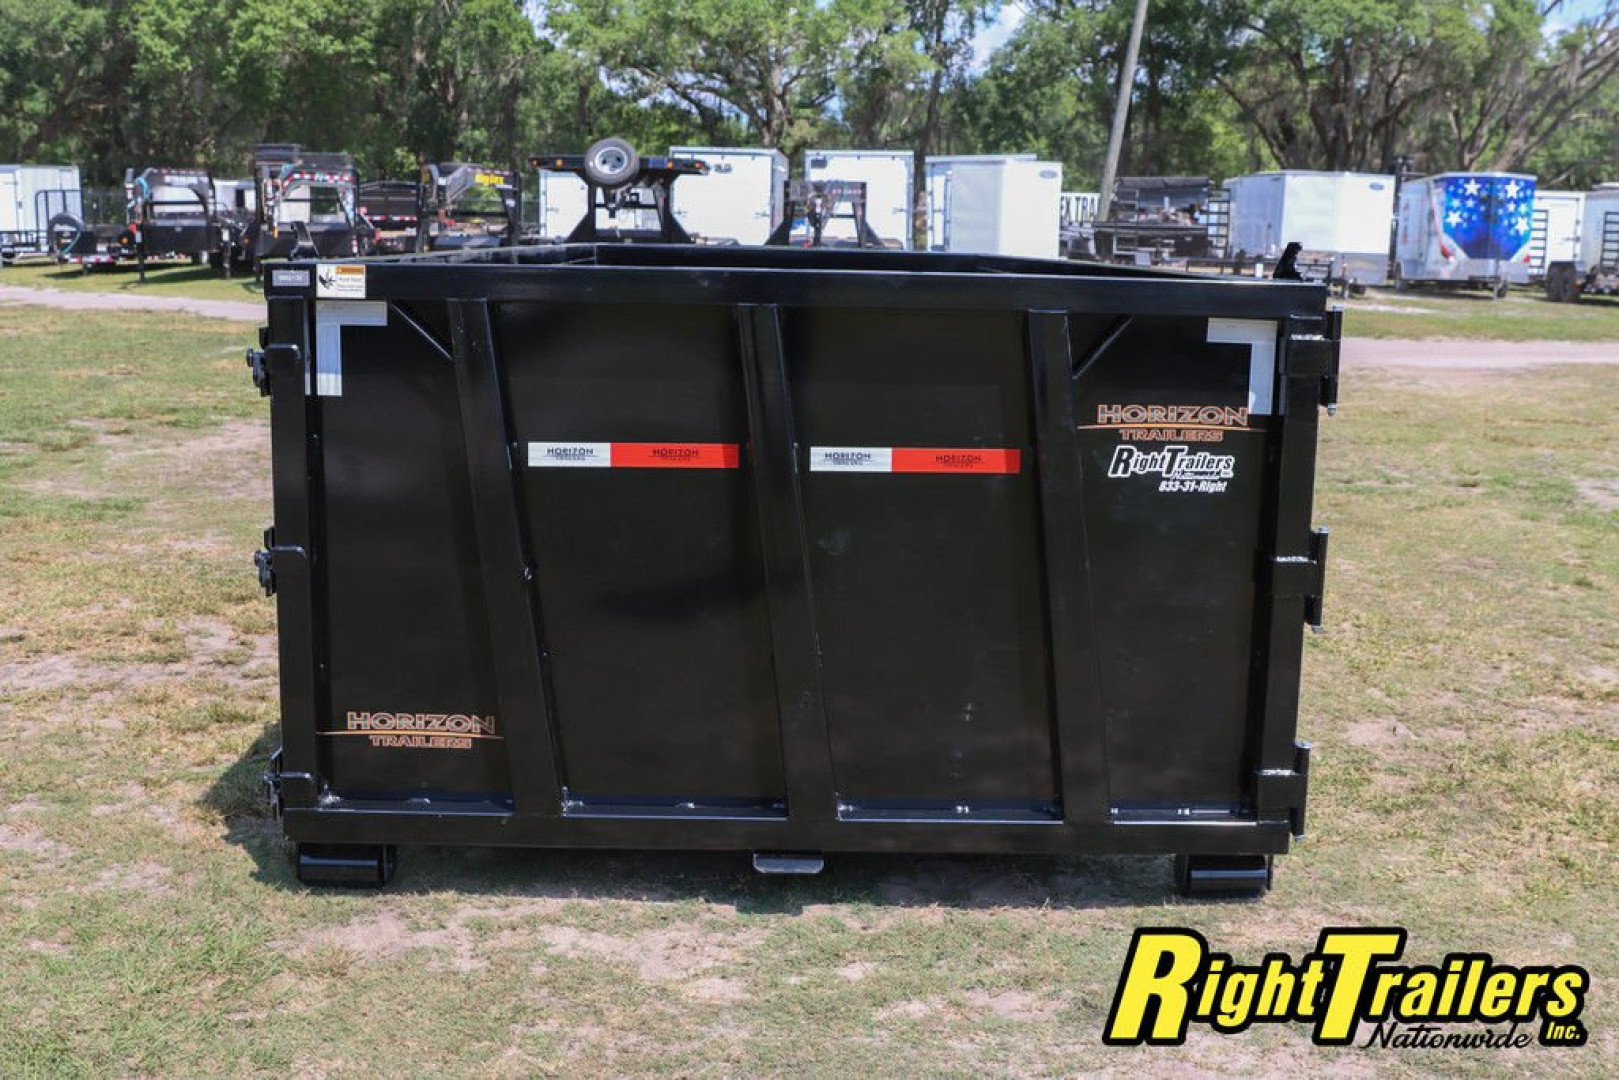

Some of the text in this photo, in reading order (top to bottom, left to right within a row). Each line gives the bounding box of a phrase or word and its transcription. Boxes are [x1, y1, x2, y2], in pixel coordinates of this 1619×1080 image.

[1097, 404, 1248, 426] HORIZON
[1119, 429, 1223, 442] TRAILERS
[546, 447, 594, 456] HORIZON
[652, 448, 699, 457] HORIZON
[824, 452, 872, 461] HORIZON
[1158, 480, 1227, 494] 833-31-Right
[347, 711, 496, 735] HORIZON
[369, 734, 472, 749] TRAILERS
